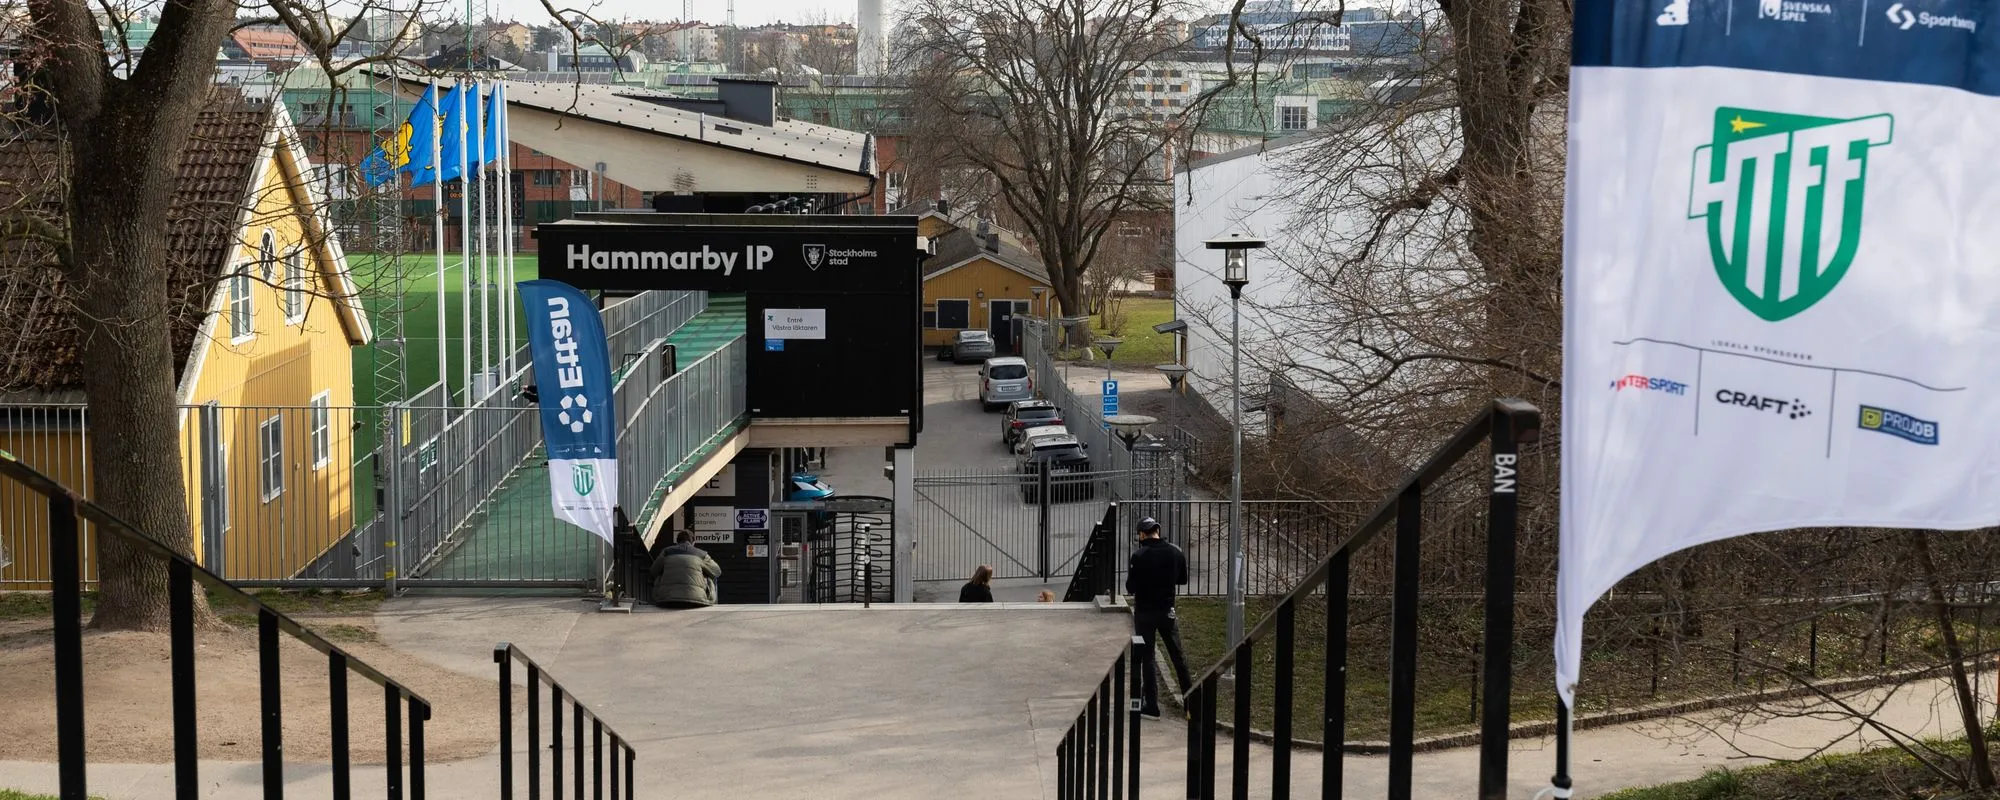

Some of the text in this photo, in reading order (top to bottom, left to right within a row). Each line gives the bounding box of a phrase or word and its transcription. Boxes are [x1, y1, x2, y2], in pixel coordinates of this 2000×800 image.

[1782, 1, 1832, 14] SVENSKA
[1781, 12, 1807, 22] SPEL
[828, 248, 878, 258] Stockholms
[567, 244, 775, 276] Hammarby IP
[828, 257, 849, 266] stad
[1106, 382, 1116, 395] P
[1715, 389, 1789, 415] CRAFT
[1883, 411, 1936, 438] PROJOB
[1494, 453, 1517, 493] BAN
